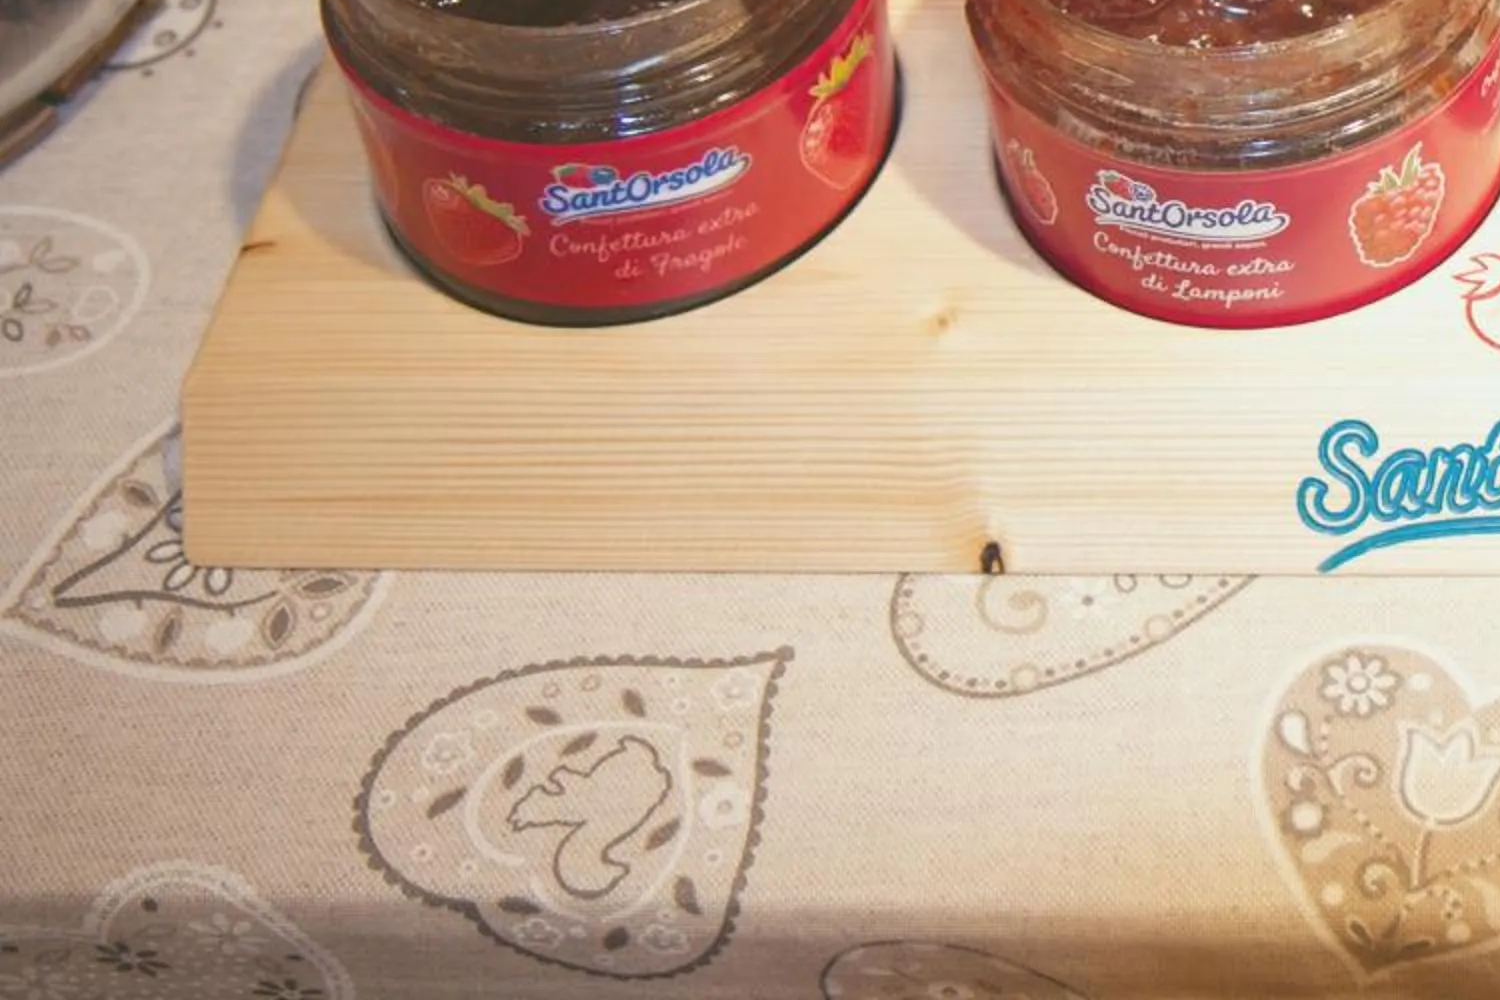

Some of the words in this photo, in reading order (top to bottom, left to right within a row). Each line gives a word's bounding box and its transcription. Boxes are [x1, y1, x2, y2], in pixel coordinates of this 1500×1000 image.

[542, 148, 736, 214] SantOrsola
[1089, 186, 1274, 229] SantOrsola
[549, 226, 692, 263] Confettura
[697, 202, 760, 234] extra
[1092, 231, 1220, 275] Confettura
[1226, 257, 1295, 276] extra
[614, 261, 644, 279] di
[1141, 273, 1168, 292] di
[1172, 279, 1285, 309] Lamponi
